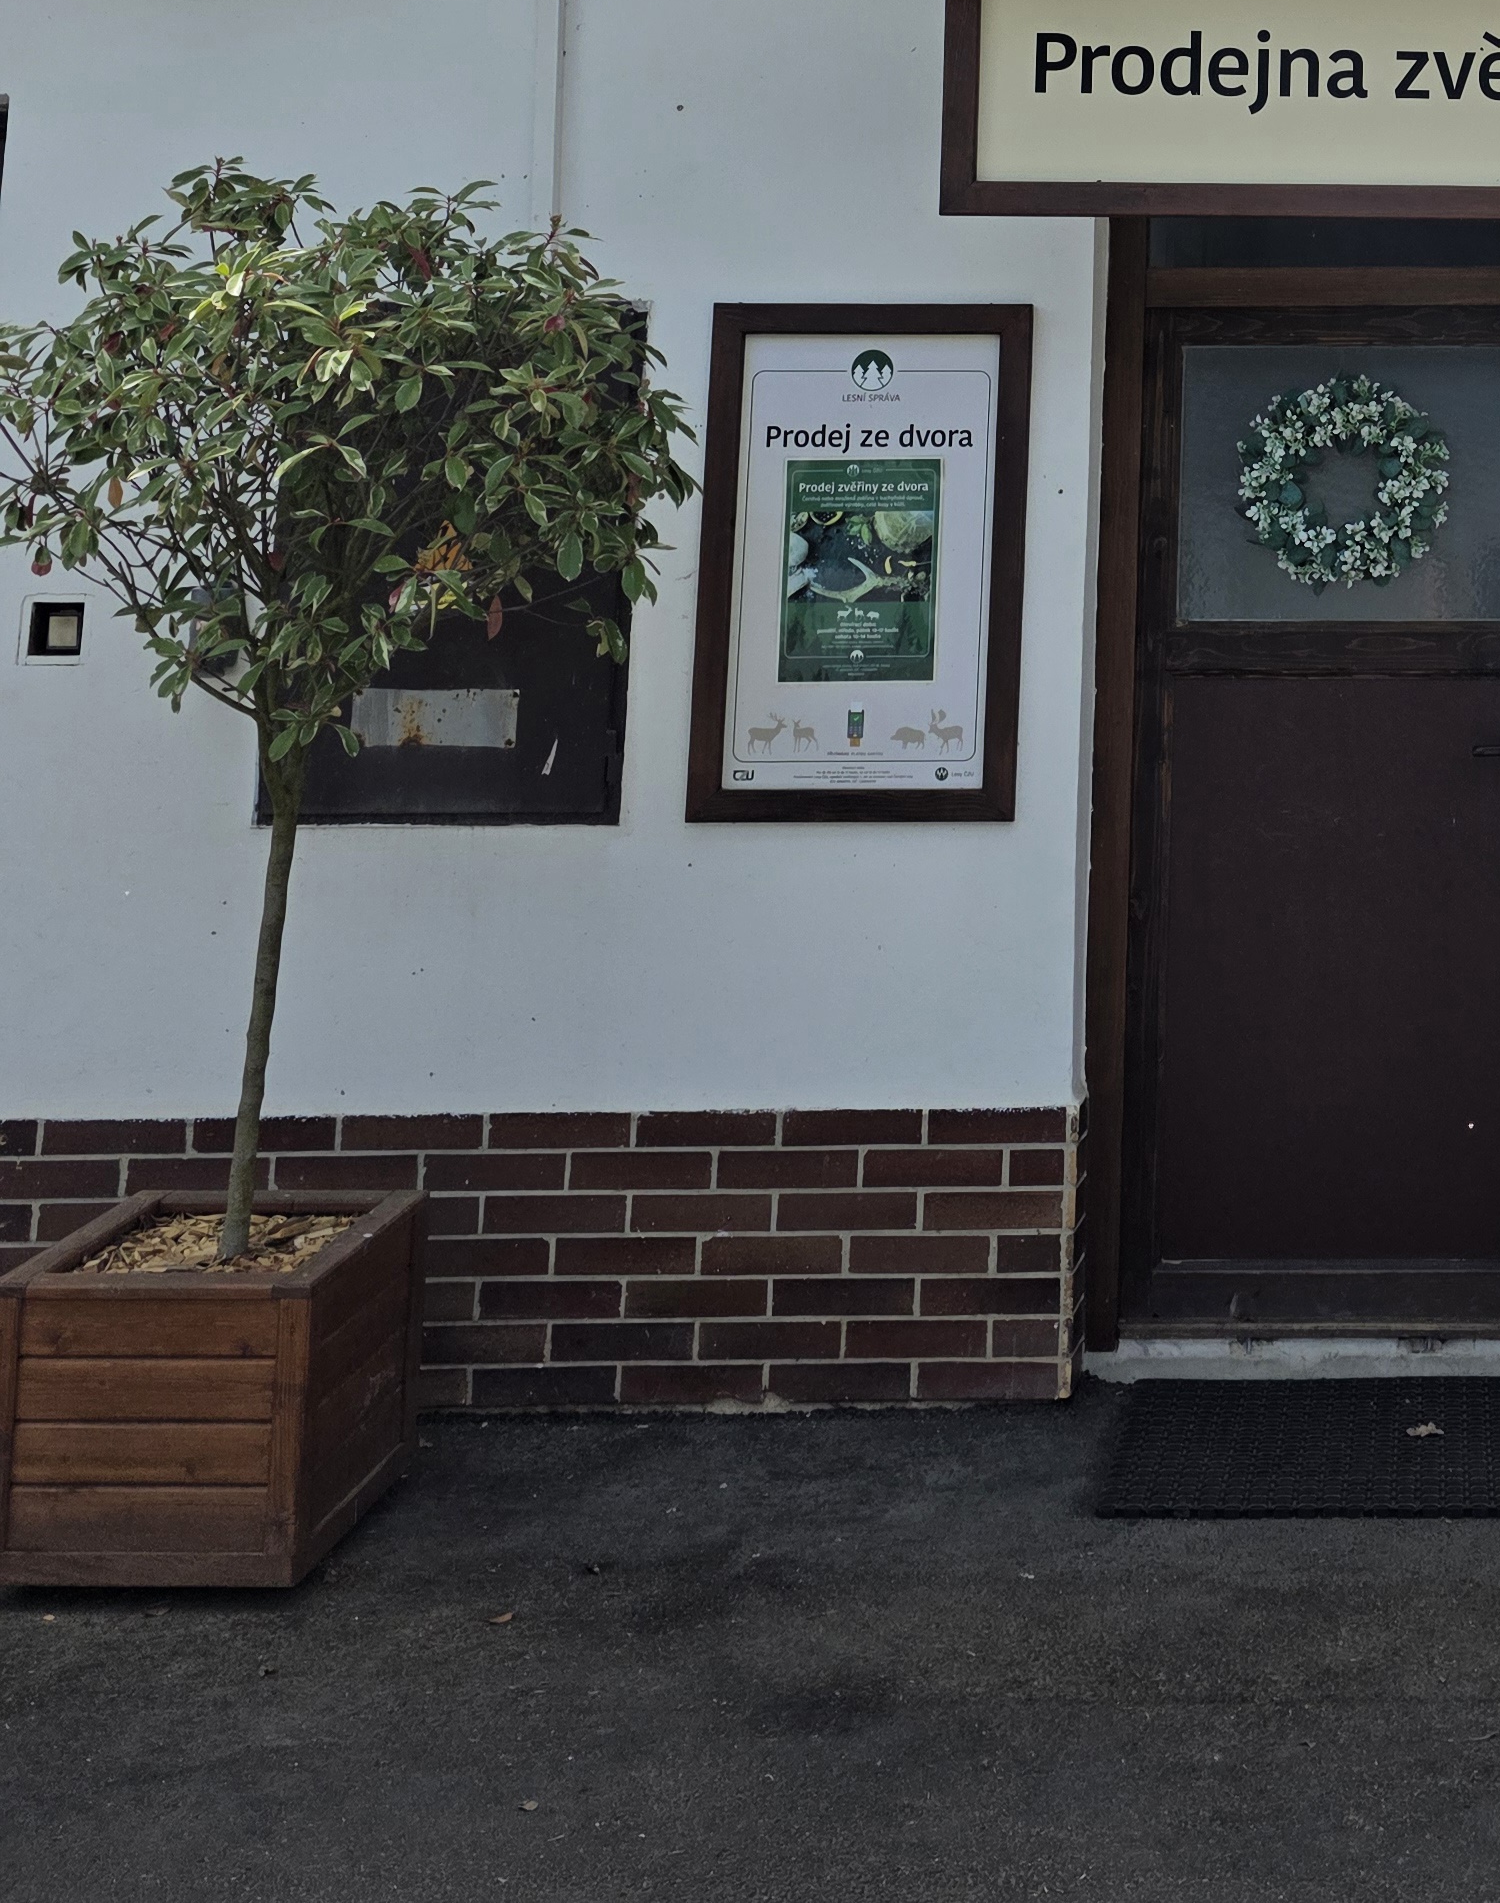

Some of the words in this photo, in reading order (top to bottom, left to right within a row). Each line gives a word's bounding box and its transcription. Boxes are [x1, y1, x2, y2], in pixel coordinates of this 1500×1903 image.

[1034, 29, 1369, 115] Prodejna
[842, 392, 867, 402] LESNÍ
[868, 392, 900, 402] SPRÁVA
[765, 423, 851, 454] Prodej
[860, 429, 890, 447] ze
[898, 424, 973, 447] dvora
[799, 482, 835, 494] Prodej
[838, 481, 879, 494] zvěřiny
[881, 483, 895, 492] ze
[897, 481, 929, 492] dvora
